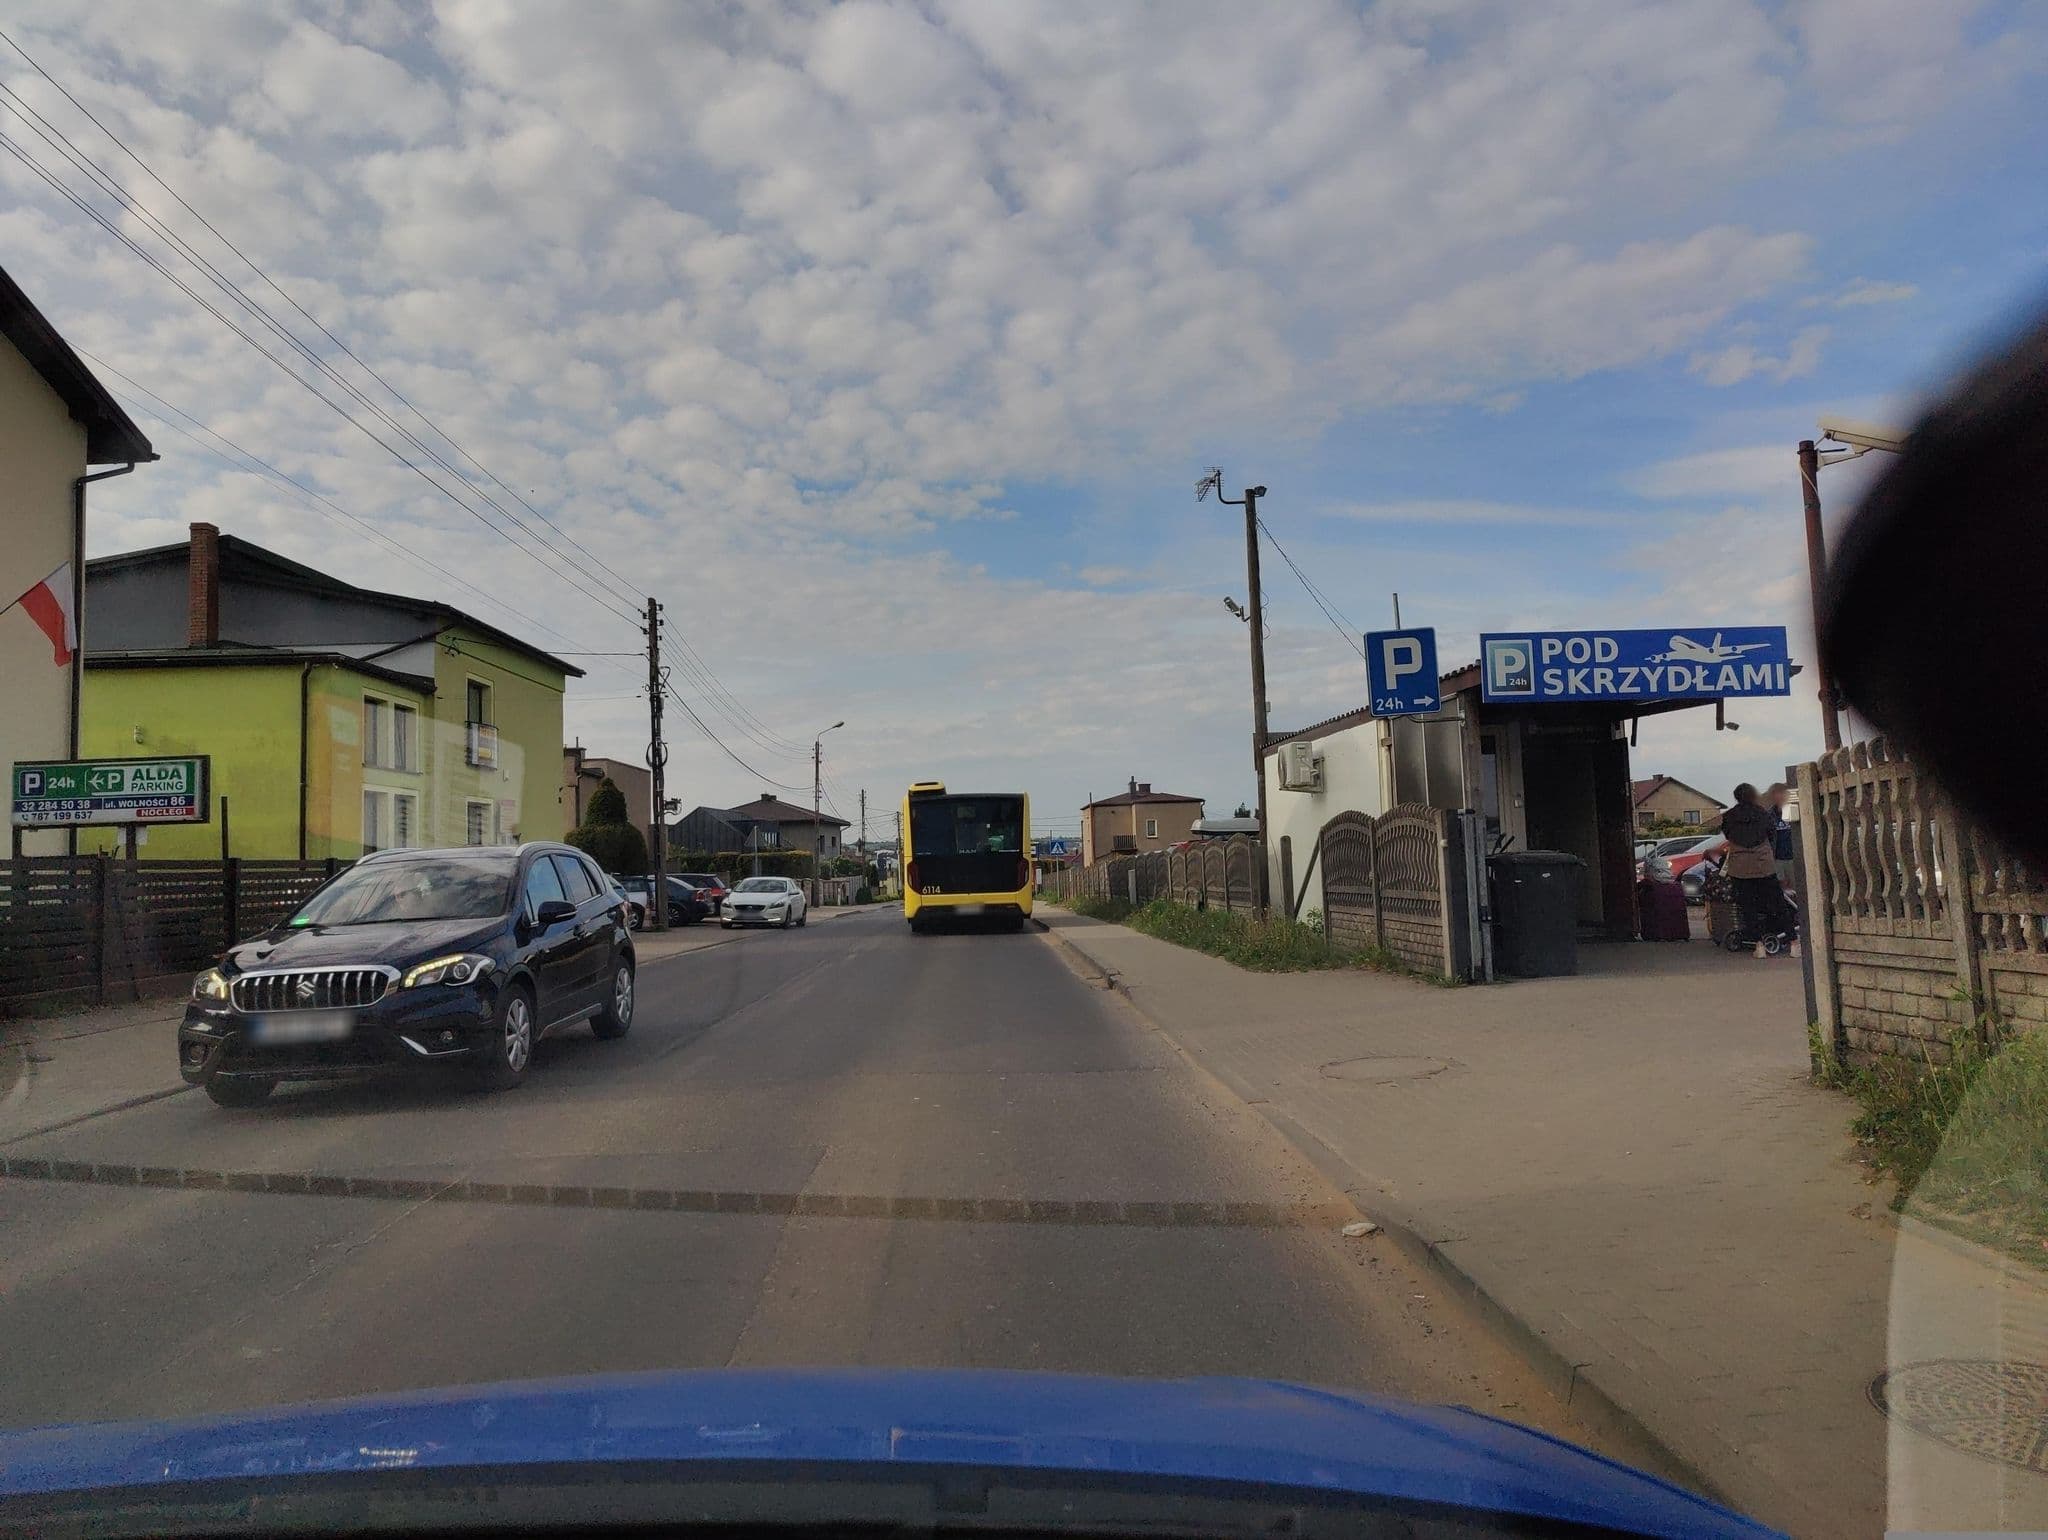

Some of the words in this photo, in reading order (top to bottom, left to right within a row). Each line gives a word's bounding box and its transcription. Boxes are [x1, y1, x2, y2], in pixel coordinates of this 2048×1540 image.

[1541, 637, 1619, 664] POD
[1383, 637, 1423, 690] P
[1495, 648, 1526, 687] P
[1510, 678, 1527, 686] 24h
[1543, 664, 1785, 695] SKRZYDŁAMI
[1376, 697, 1403, 711] 24h
[132, 768, 182, 781] ALDA
[24, 773, 41, 794] P
[48, 777, 75, 789] 24h
[107, 773, 121, 790] P
[131, 781, 184, 792] PARKING
[21, 801, 35, 811] 32
[37, 801, 58, 811] 284
[60, 800, 74, 810] 50
[77, 799, 90, 809] 38
[118, 798, 168, 808] WOLNOŚCI
[170, 796, 186, 806] 86
[53, 811, 71, 820] 199
[141, 808, 186, 817] NOCLEGI
[922, 885, 941, 895] 6114
